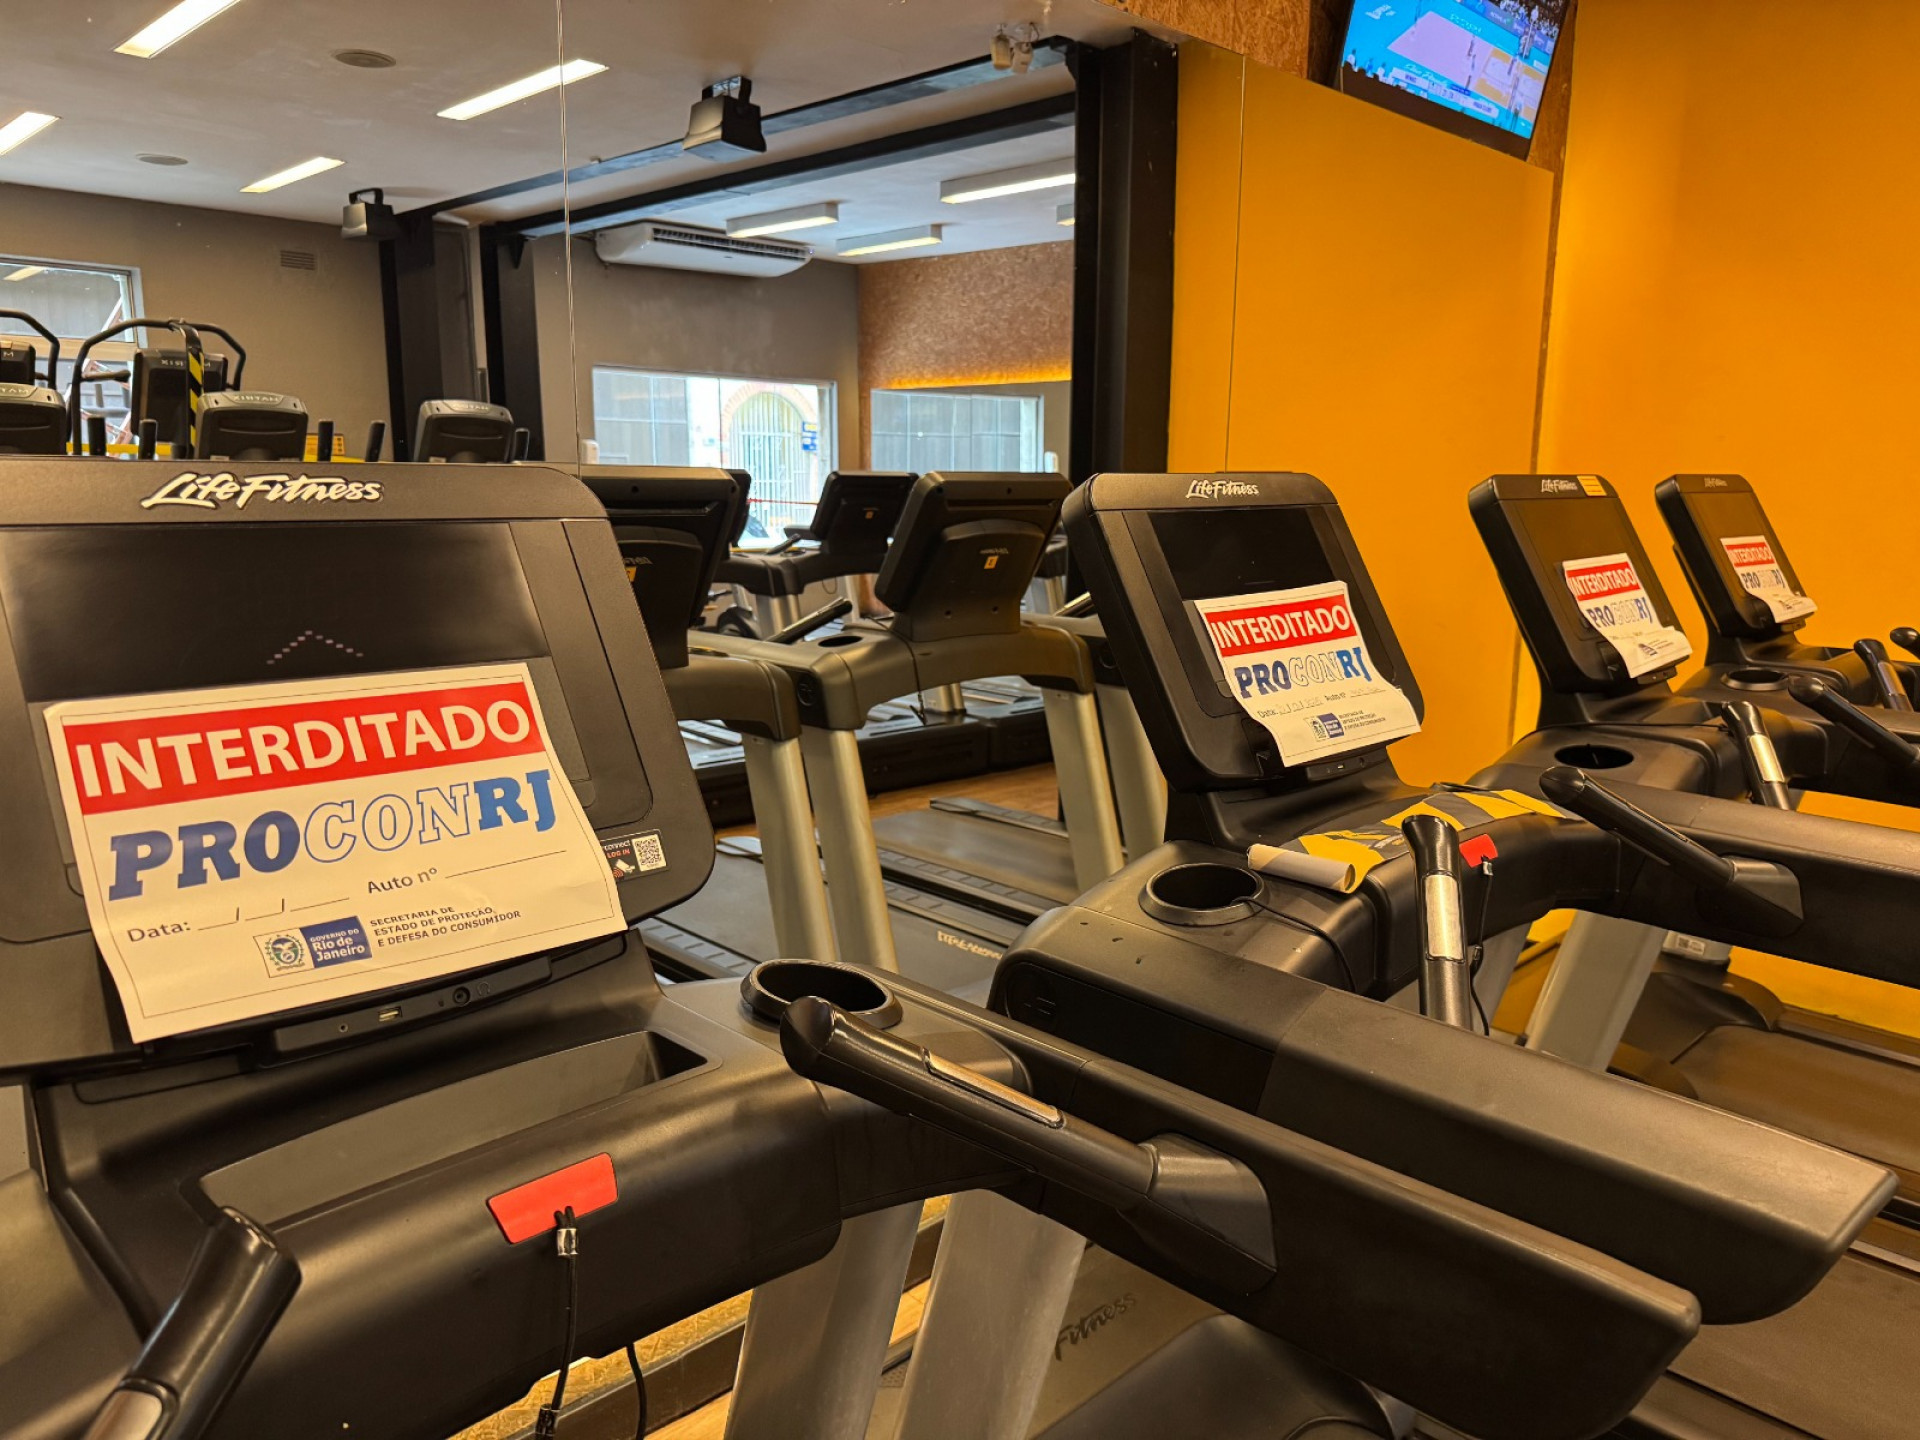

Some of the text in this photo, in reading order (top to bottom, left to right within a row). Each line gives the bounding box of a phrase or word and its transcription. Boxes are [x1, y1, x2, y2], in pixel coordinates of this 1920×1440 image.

[1568, 568, 1639, 596] INTERDITADO
[1741, 568, 1786, 589] PRORJ
[1210, 604, 1351, 649] INTERDITADO
[75, 699, 532, 798] INTERDITADO
[606, 848, 631, 859] LOG IN
[126, 918, 191, 943] Data:
[367, 876, 414, 894] Auto
[370, 906, 456, 927] SECRETARIA DE
[309, 928, 360, 943] GOVERNO DO
[373, 921, 418, 937] ESTADO
[420, 917, 436, 928] DE
[377, 910, 521, 948] E DEFESA DO CONSUMIDOR
[311, 936, 354, 953] Rio de
[316, 944, 366, 962] Janeiro
[1054, 1292, 1137, 1362] Fitness
